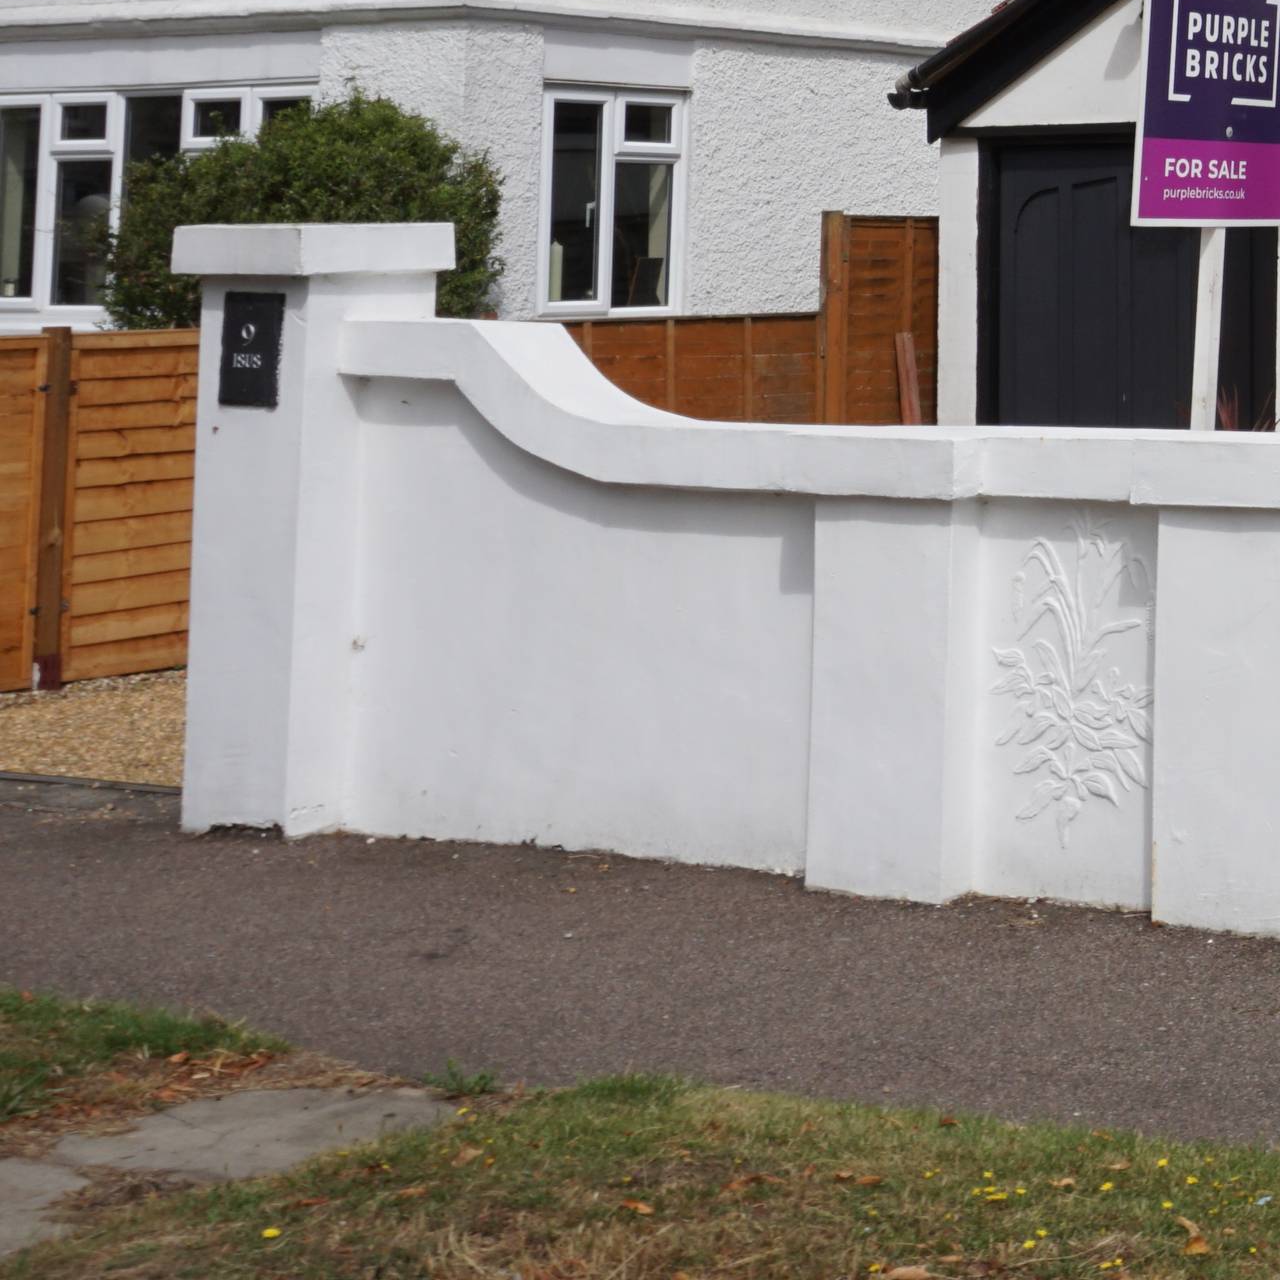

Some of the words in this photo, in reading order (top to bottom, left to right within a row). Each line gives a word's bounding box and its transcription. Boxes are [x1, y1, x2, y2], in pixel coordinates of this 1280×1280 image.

[1187, 11, 1270, 49] PURPLE
[1185, 48, 1268, 84] BRICKS
[1164, 157, 1202, 179] FOR
[1208, 159, 1247, 180] SALE
[1163, 186, 1246, 200] purplebricks.co.uk
[241, 323, 256, 346] 9
